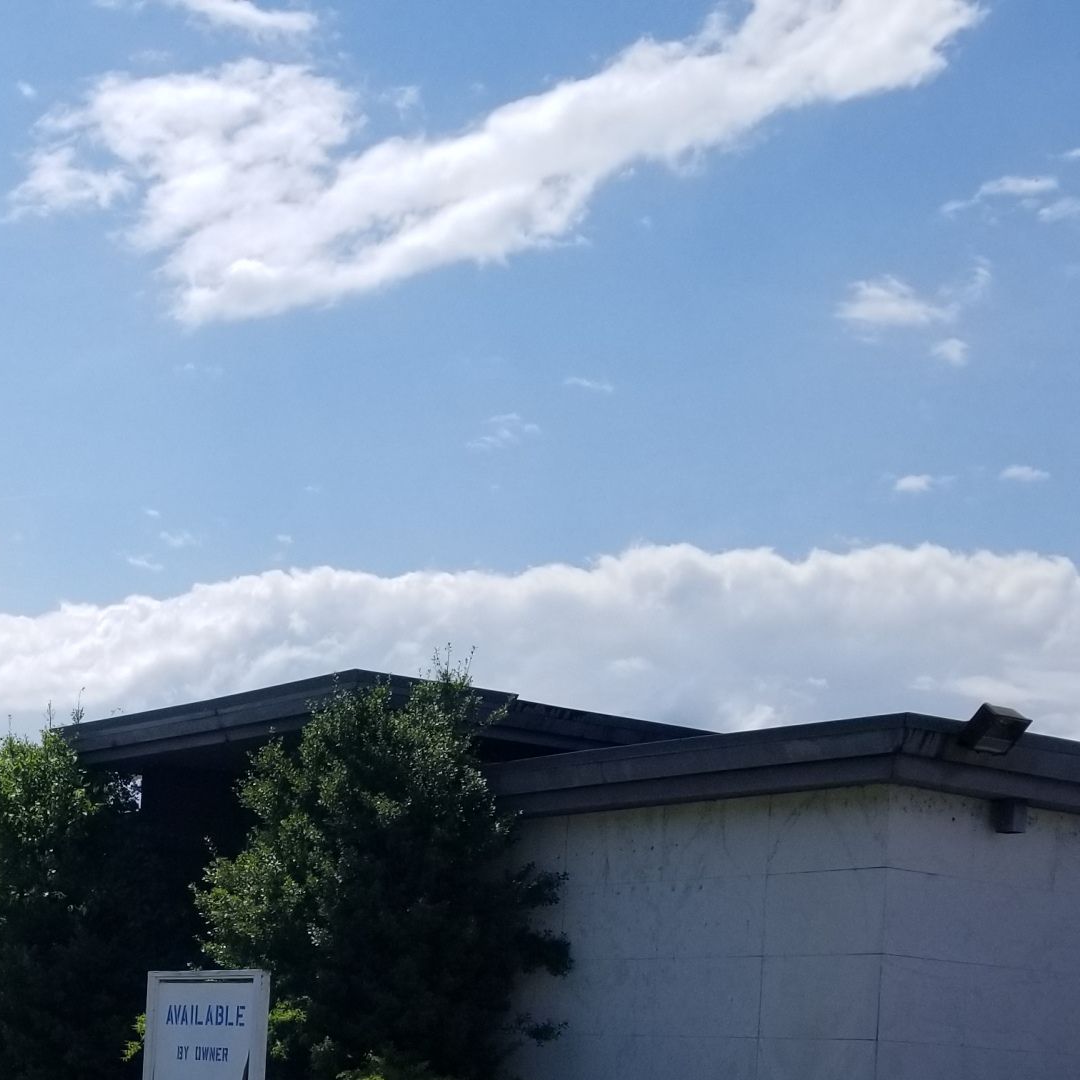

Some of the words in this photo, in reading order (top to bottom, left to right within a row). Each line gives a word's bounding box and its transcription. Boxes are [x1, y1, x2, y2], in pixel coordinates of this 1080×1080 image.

[166, 1005, 246, 1027] AVAILABLE
[177, 1046, 189, 1060] BY
[195, 1046, 229, 1062] OWNER
